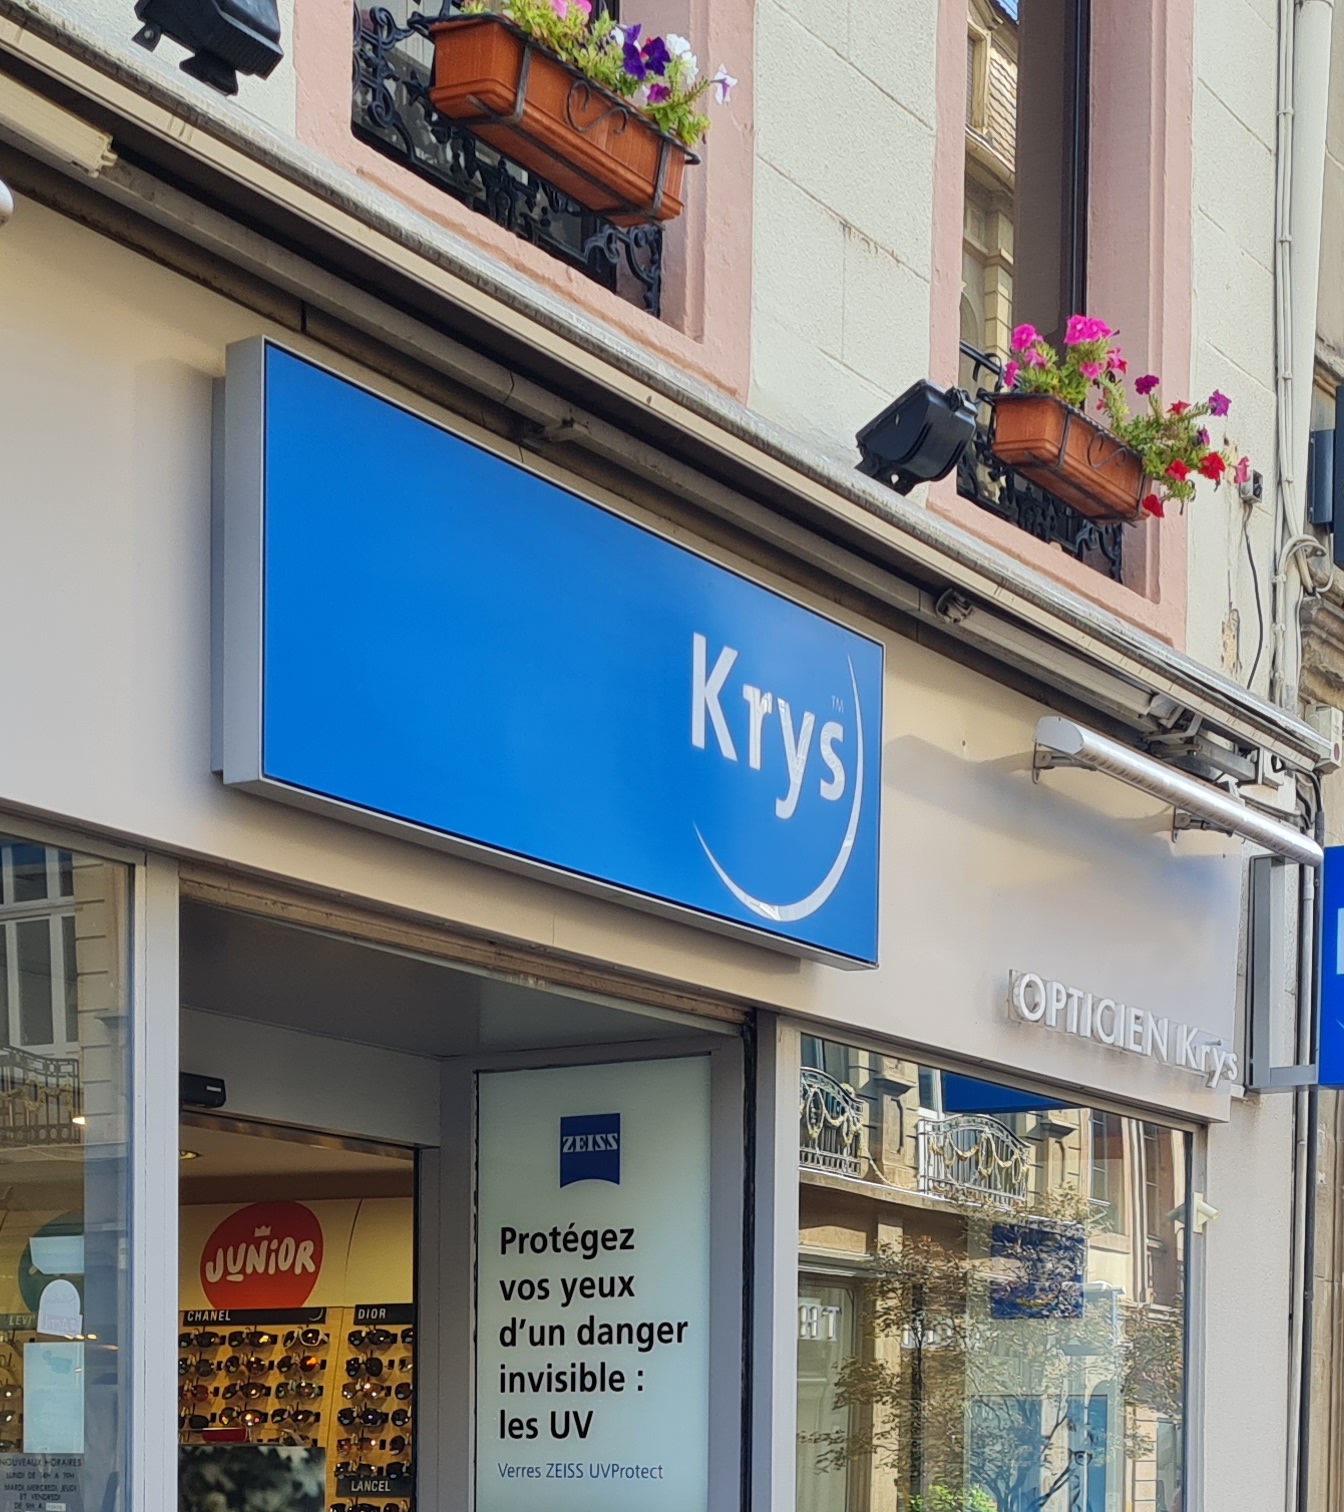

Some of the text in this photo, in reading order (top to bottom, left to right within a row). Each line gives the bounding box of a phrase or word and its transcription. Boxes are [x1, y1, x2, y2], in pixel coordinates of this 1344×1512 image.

[691, 632, 846, 820] Krys
[1012, 972, 1238, 1089] OPTICIEN Krys
[562, 1133, 618, 1153] ZEISS
[500, 1222, 635, 1260] Protégez
[499, 1275, 635, 1308] vos yeux
[187, 1310, 231, 1322] CHANEL
[358, 1308, 387, 1320] DIOR
[499, 1315, 688, 1353] d’un danger
[499, 1361, 644, 1394] invisible :
[499, 1409, 594, 1440] les UV
[44, 1458, 83, 1467] HORAIRES
[498, 1462, 664, 1480] Verres ZEISS UVProtect
[350, 1480, 391, 1493] LANCEL
